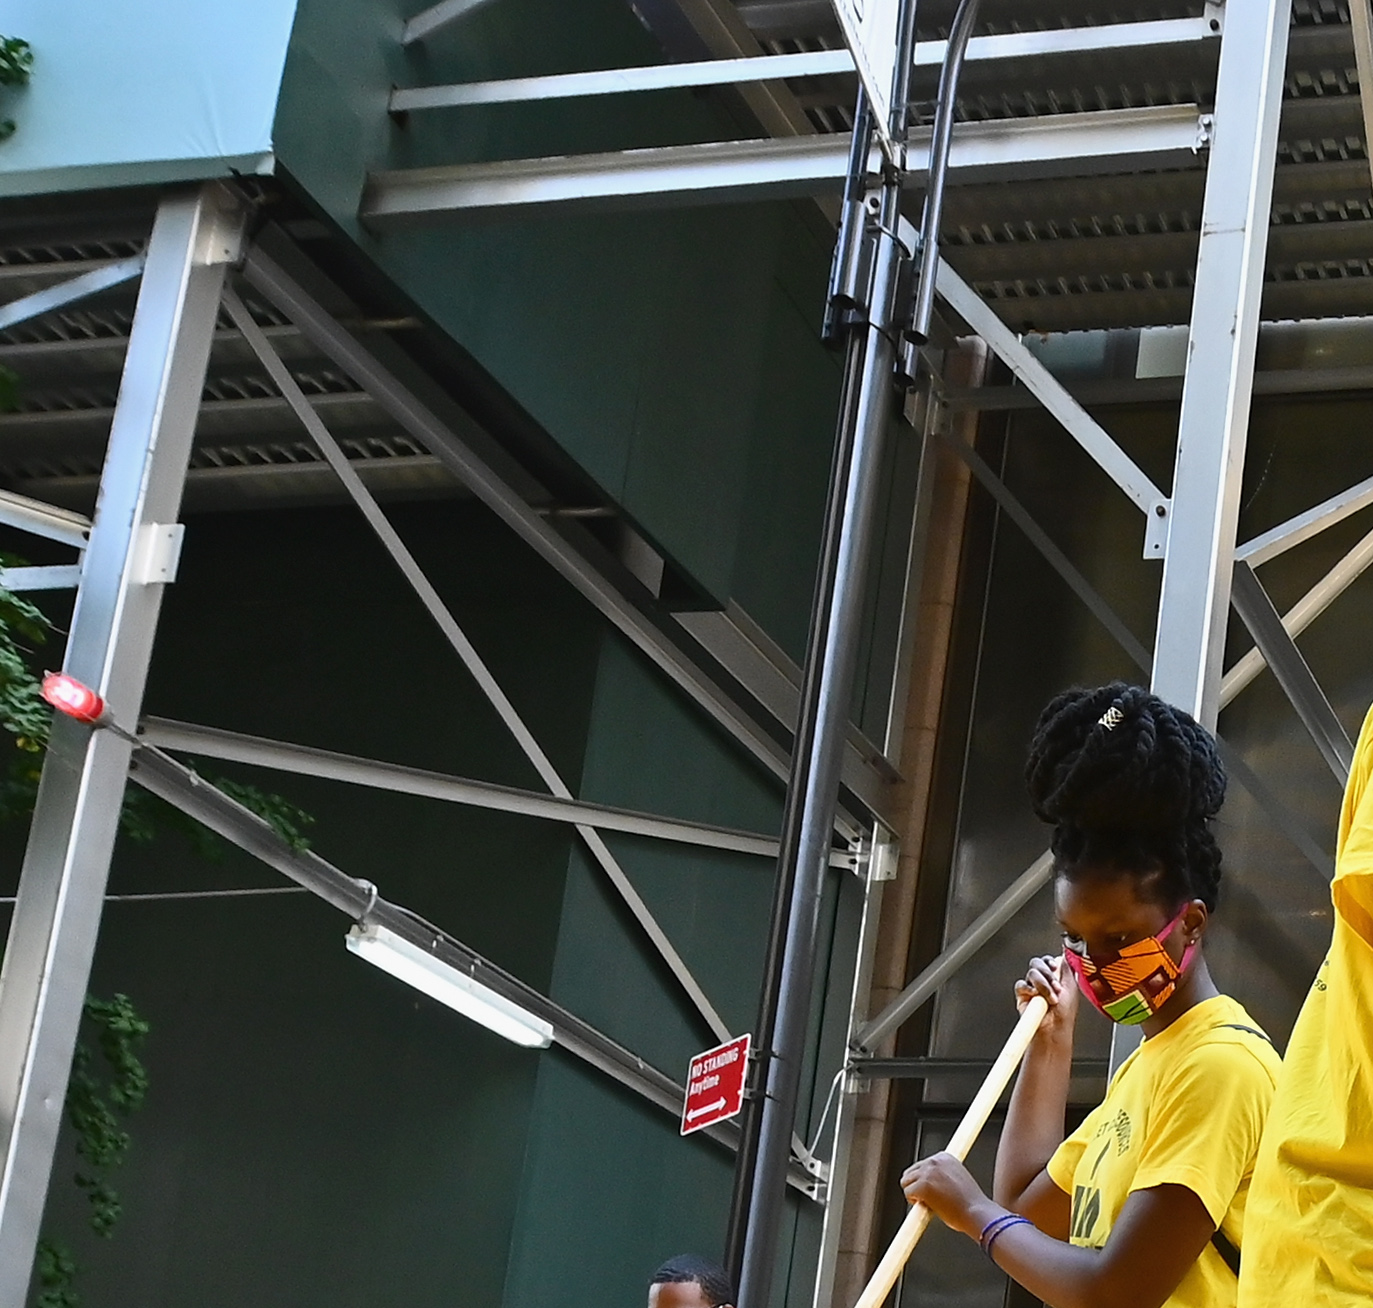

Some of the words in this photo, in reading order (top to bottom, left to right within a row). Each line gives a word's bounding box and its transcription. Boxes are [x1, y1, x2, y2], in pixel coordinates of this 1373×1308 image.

[692, 1063, 703, 1079] NO
[703, 1047, 739, 1074] STANDING
[689, 1074, 720, 1096] Anytime
